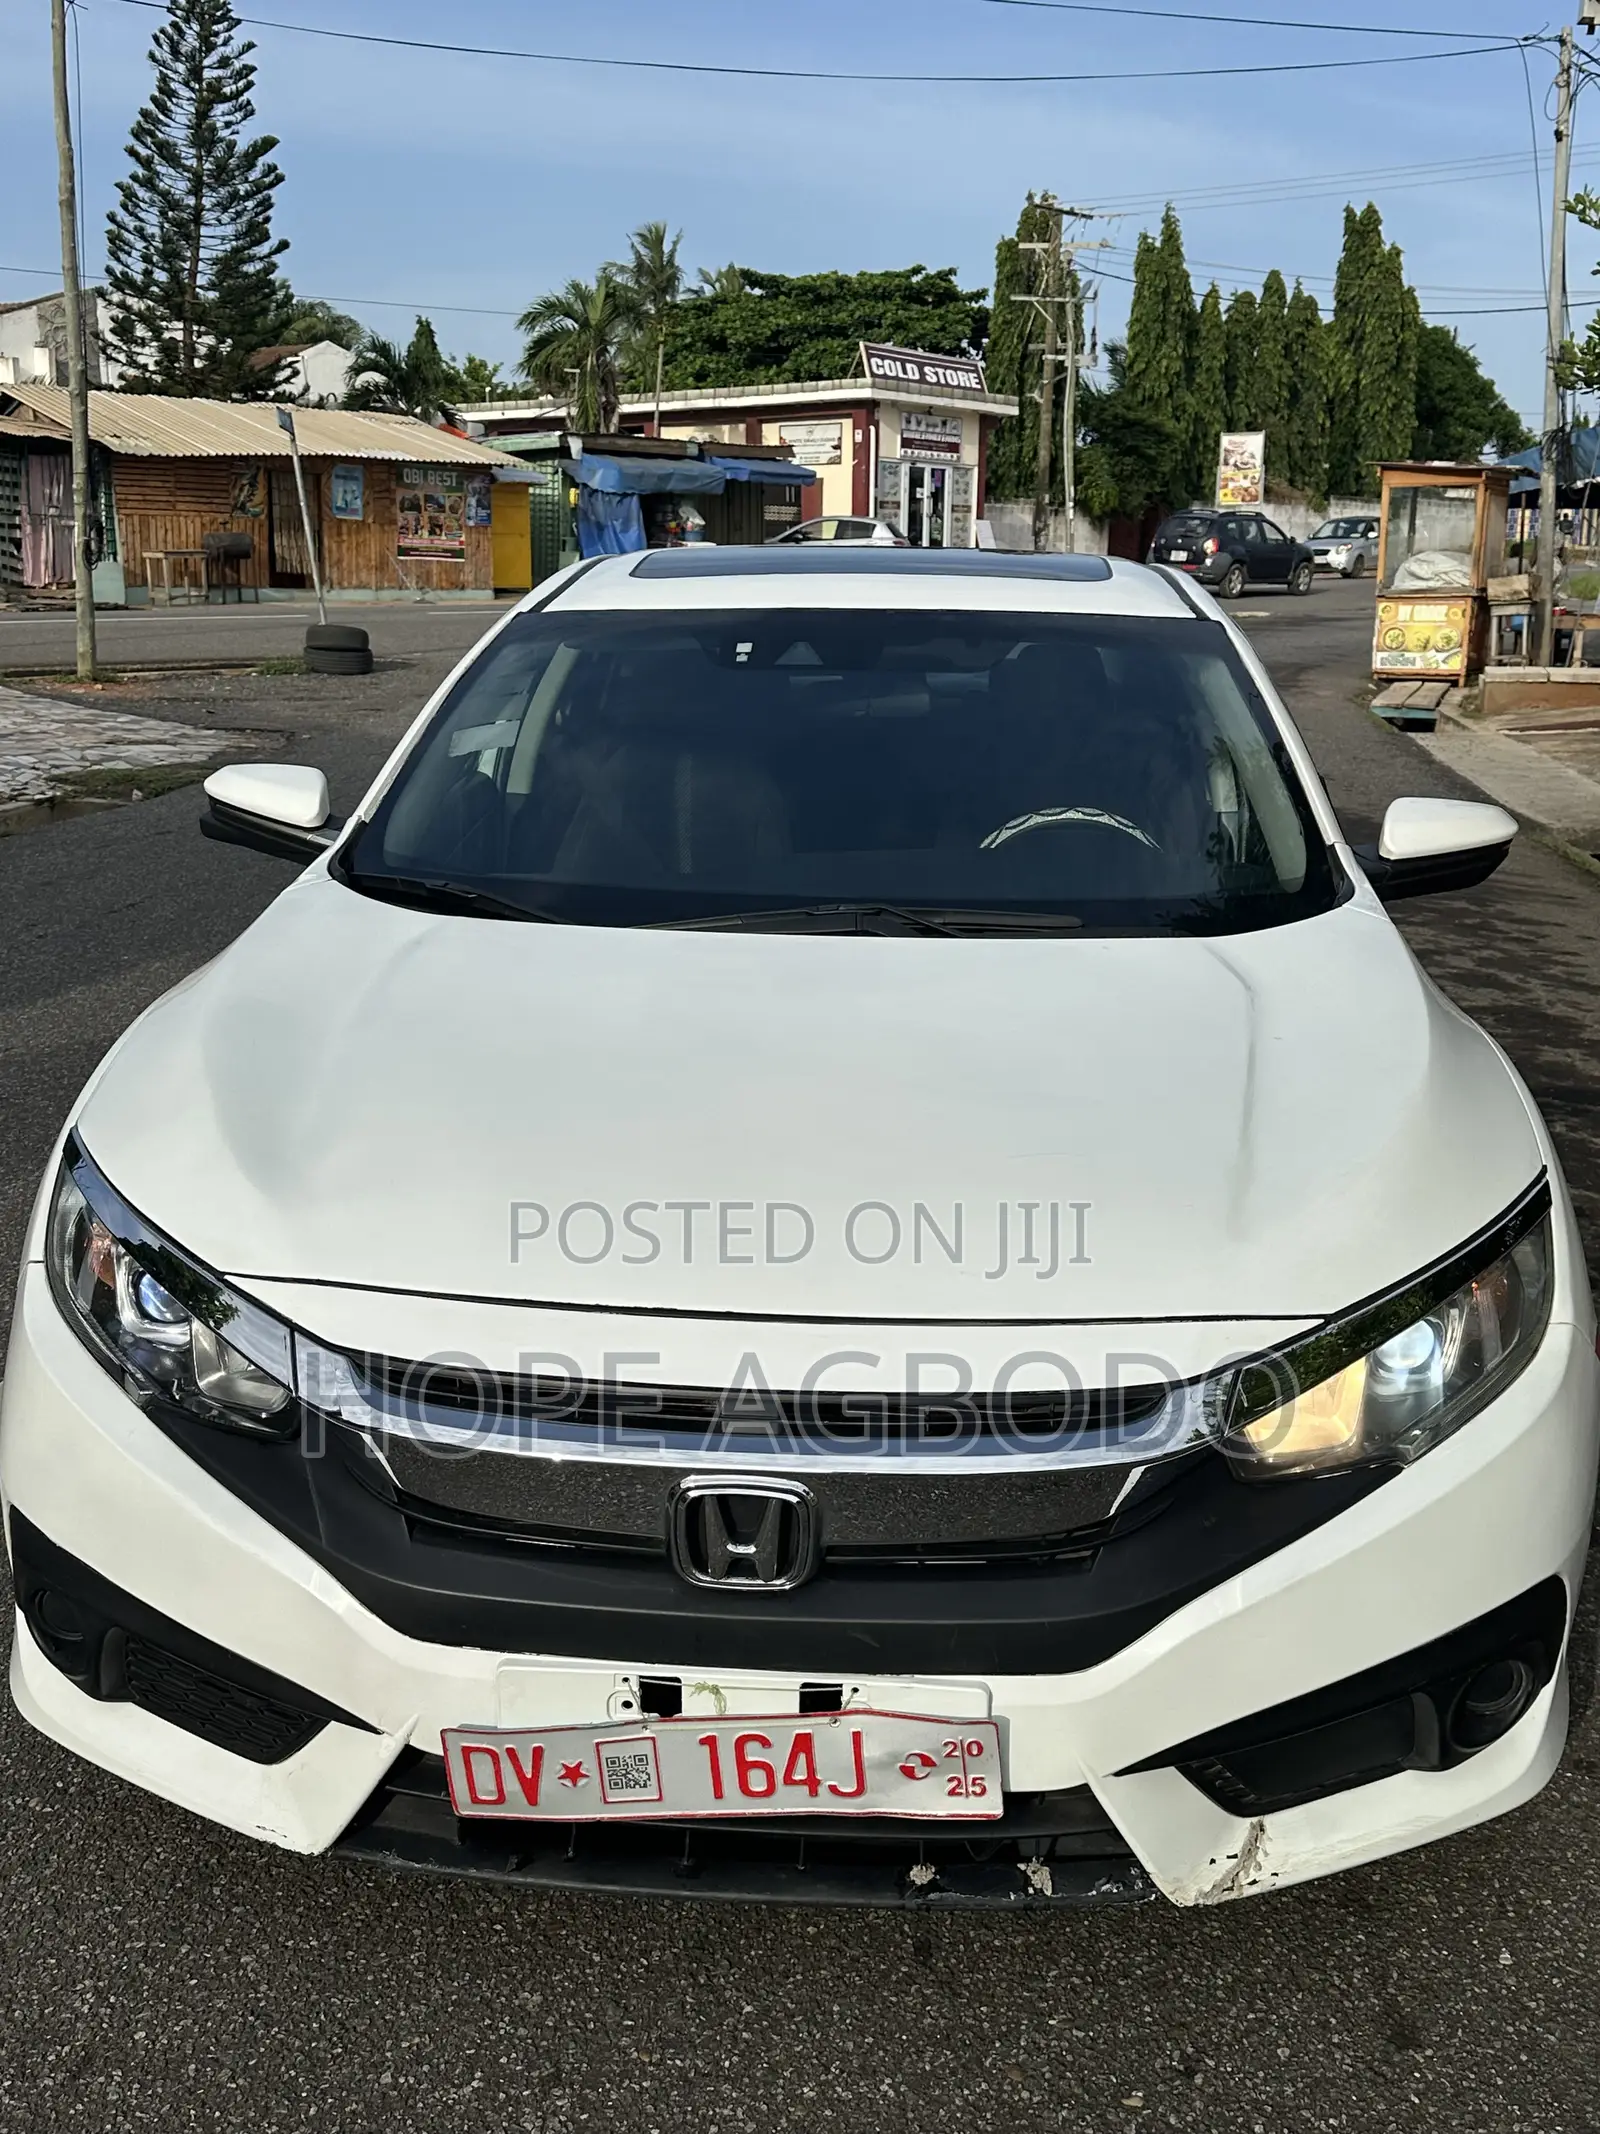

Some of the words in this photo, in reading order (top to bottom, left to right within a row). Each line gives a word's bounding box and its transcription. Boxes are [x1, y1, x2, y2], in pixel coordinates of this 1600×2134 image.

[870, 357, 920, 380] COLD
[923, 366, 982, 389] STORE
[427, 470, 458, 487] BEST
[459, 1743, 545, 1807] DV
[688, 1728, 868, 1800] 164J
